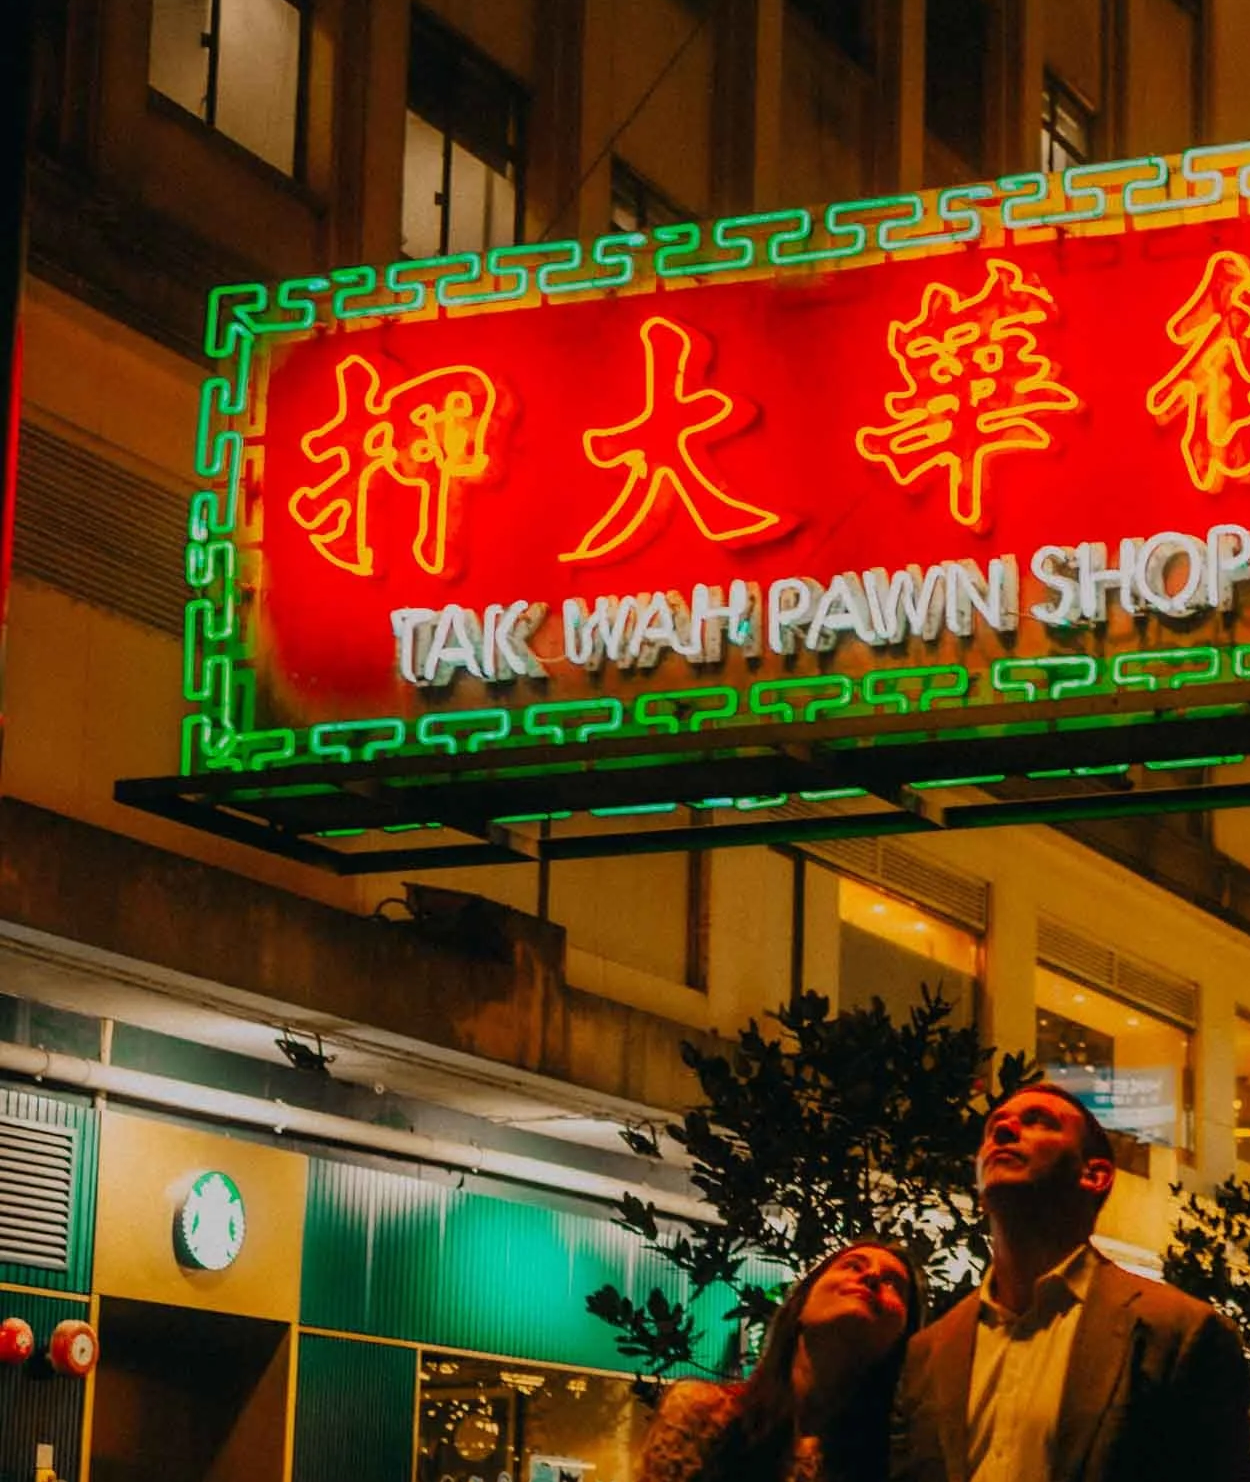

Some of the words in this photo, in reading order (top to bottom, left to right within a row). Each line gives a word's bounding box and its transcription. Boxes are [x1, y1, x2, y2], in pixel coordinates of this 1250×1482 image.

[390, 599, 549, 687] TAK
[561, 577, 762, 671] WAH
[768, 554, 1019, 655] PAWN
